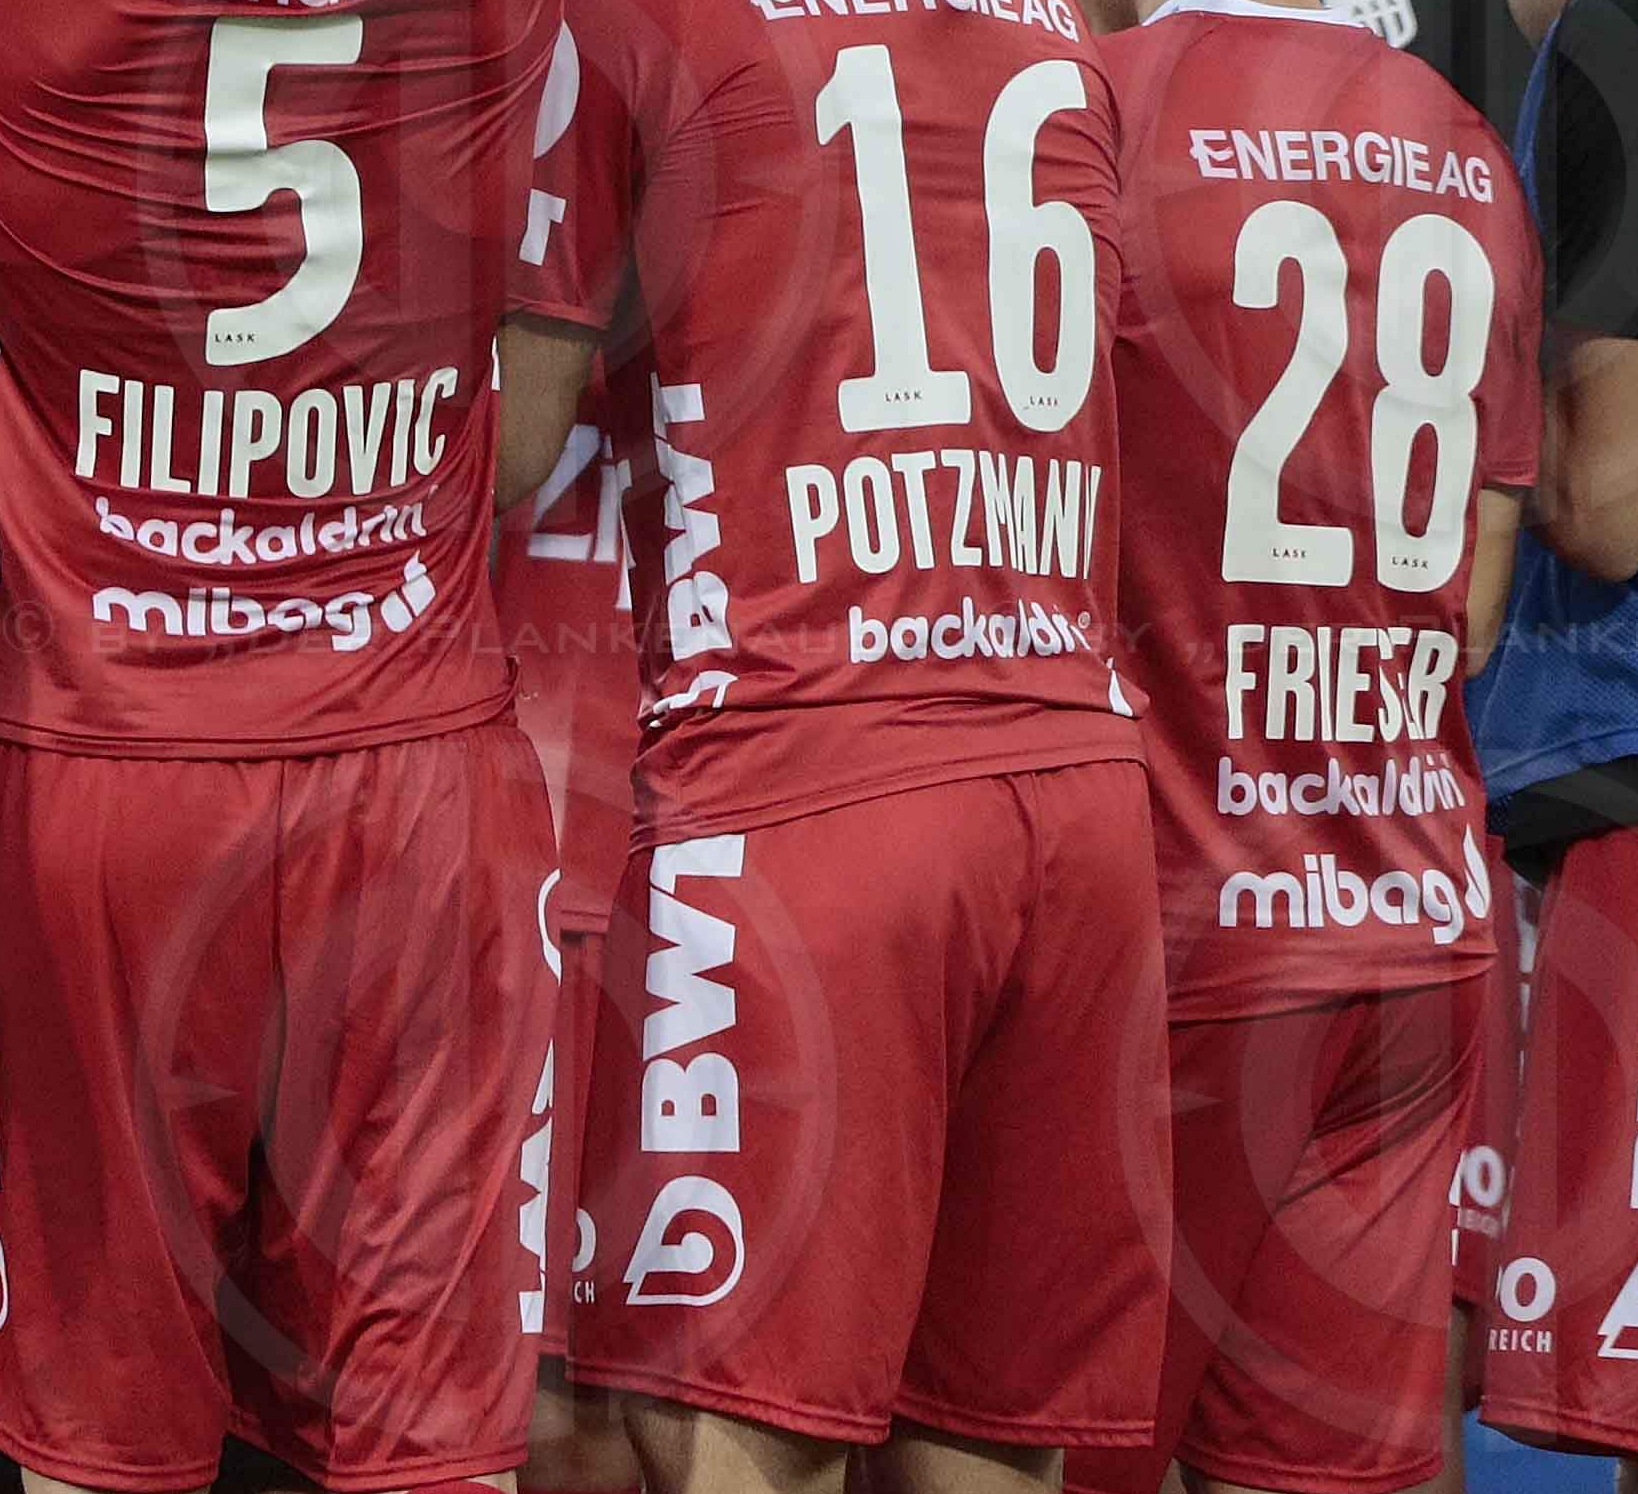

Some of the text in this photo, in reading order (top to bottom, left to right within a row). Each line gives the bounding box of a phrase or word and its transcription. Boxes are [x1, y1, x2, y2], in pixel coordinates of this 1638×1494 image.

[204, 13, 365, 368] 5
[814, 43, 1098, 433] 16
[74, 365, 460, 500] FILIPOVIC
[650, 371, 734, 663] BWT
[1220, 198, 1497, 594] 28
[92, 585, 376, 652] mibag
[640, 833, 746, 1153] BWT
[1219, 853, 1465, 946] mibag
